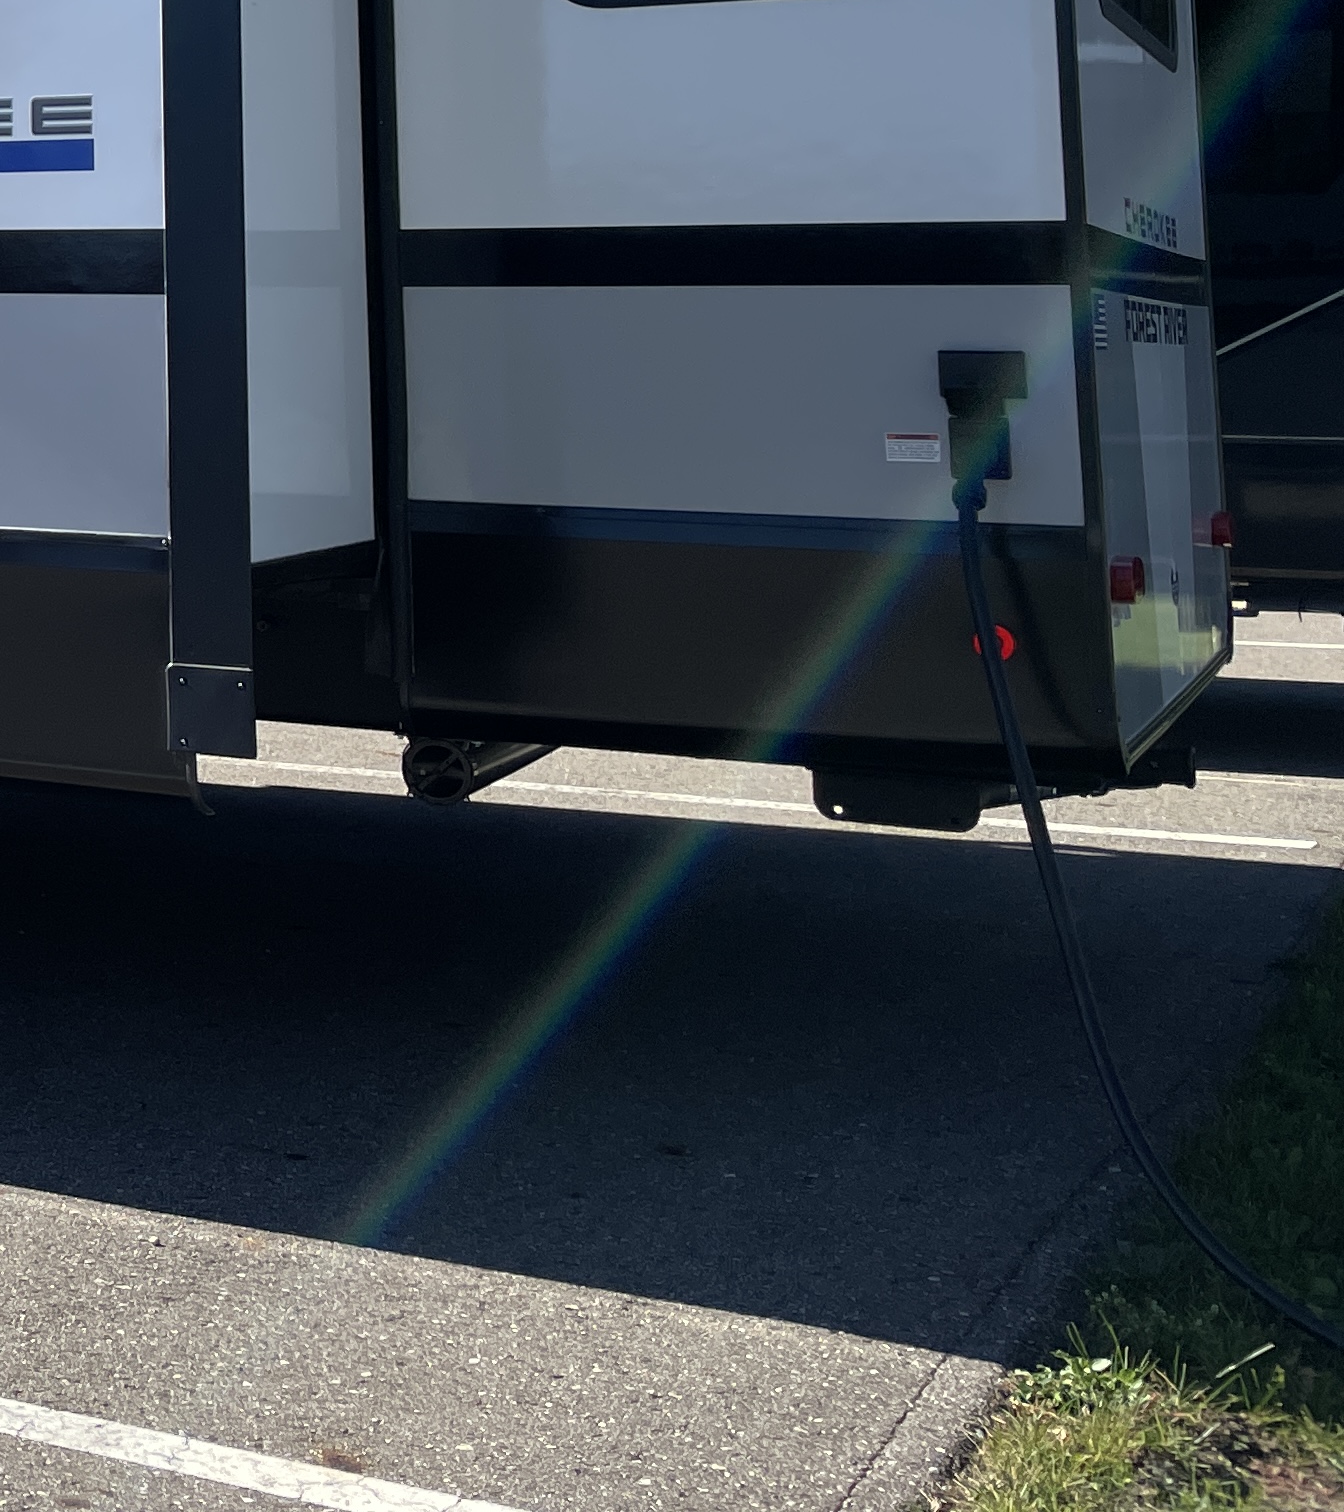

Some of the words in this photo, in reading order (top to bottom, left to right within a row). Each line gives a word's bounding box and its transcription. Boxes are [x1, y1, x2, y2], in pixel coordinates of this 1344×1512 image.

[1123, 197, 1178, 249] CHEROKEE
[1124, 299, 1162, 345] FOREST
[1163, 306, 1189, 346] RIVER
